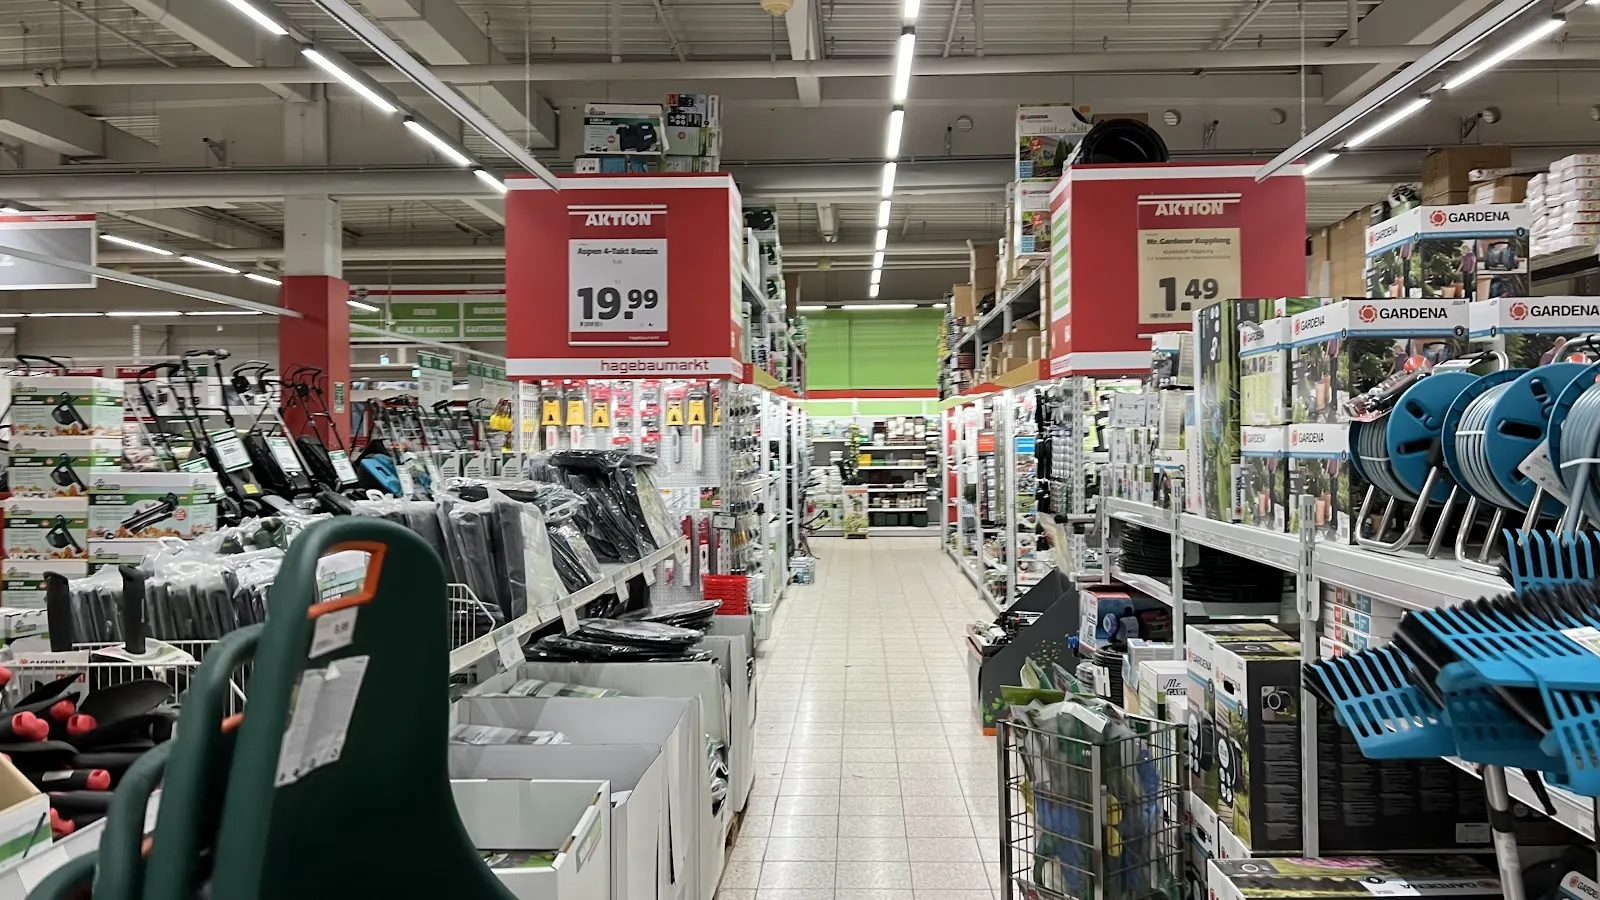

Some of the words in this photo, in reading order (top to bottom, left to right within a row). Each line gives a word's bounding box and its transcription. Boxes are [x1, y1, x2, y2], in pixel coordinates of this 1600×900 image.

[1155, 202, 1225, 217] AKTION
[1448, 211, 1510, 224] GARDENA
[584, 210, 652, 227] AKTION
[1374, 223, 1399, 243] GARDENA
[603, 247, 630, 255] 4-Takt
[1158, 276, 1220, 312] 1.49
[577, 286, 659, 321] 19.99
[1530, 304, 1600, 317] GARDENA
[1379, 307, 1448, 320] GARDENA
[1300, 315, 1325, 331] GARDENA
[600, 358, 709, 374] hagebaumarkt
[1247, 433, 1266, 443] GARDENA
[1298, 432, 1325, 443] GARDENA
[1192, 652, 1212, 672] GARDENA
[1577, 881, 1600, 899] GARDE
